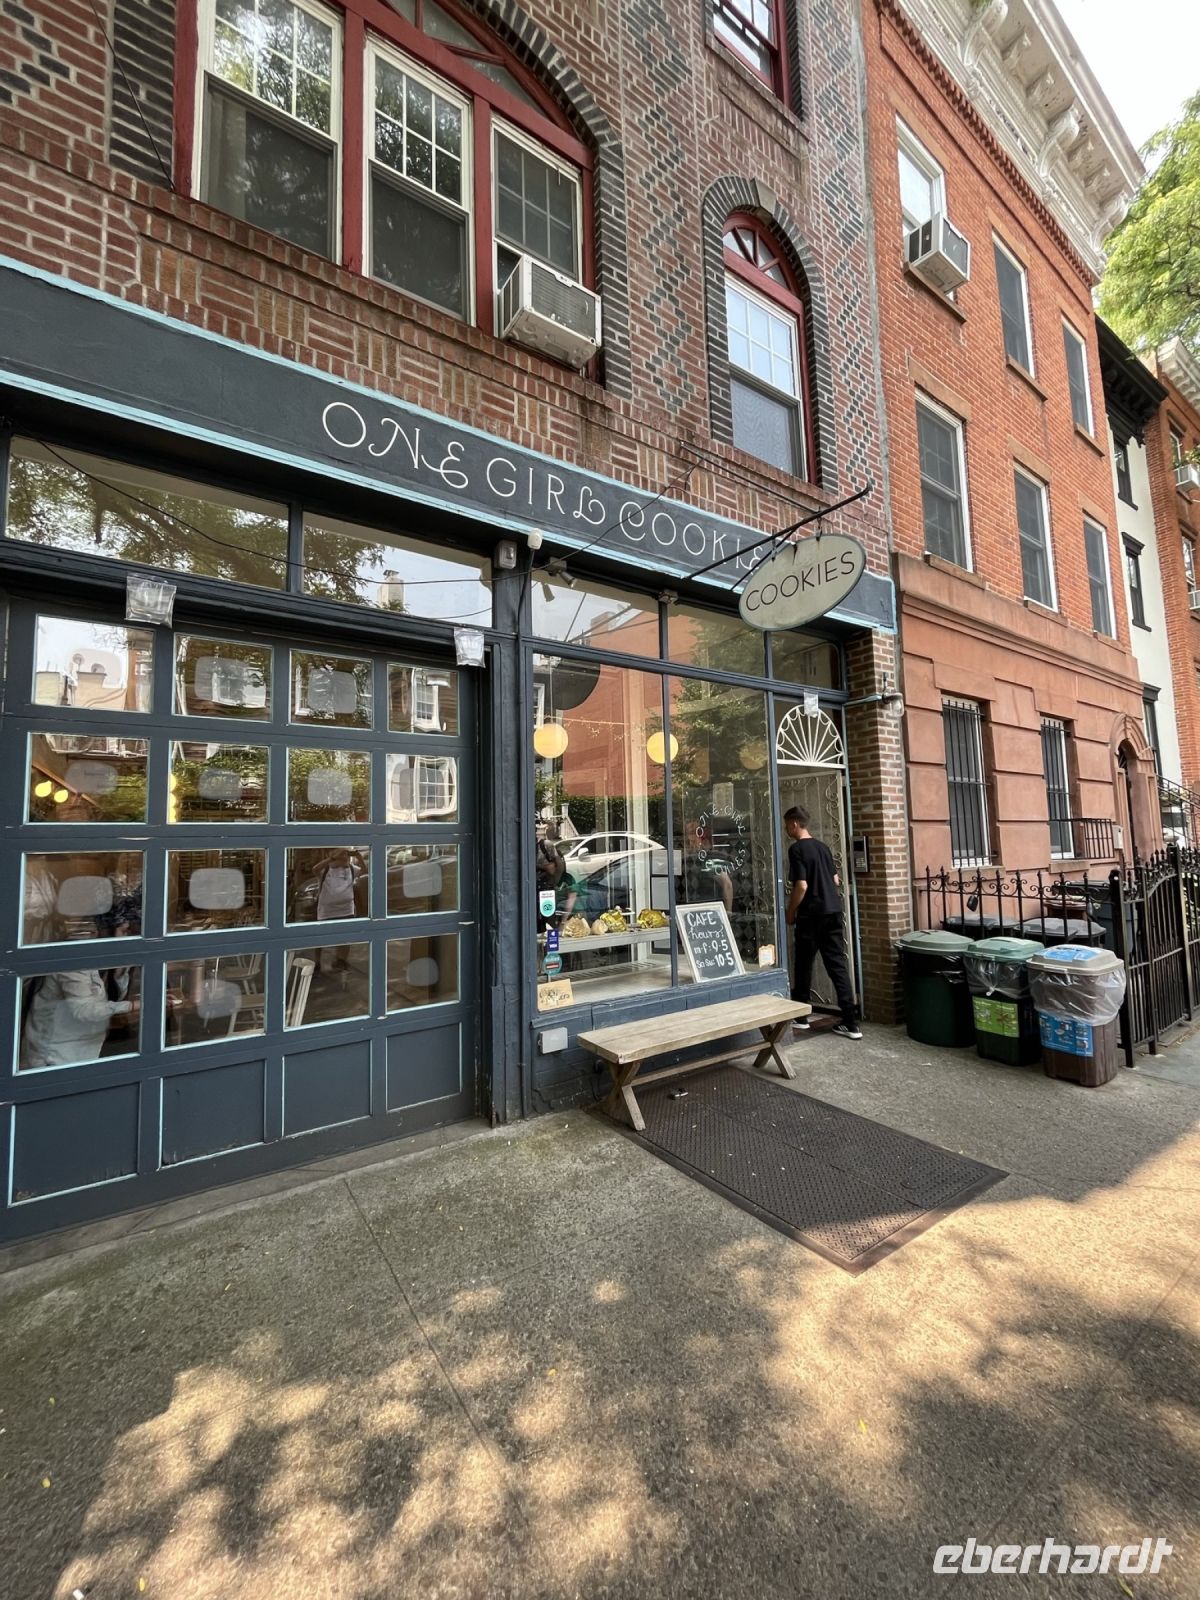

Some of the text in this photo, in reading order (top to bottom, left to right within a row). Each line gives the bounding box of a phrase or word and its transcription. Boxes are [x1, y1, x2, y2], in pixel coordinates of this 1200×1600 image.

[322, 401, 763, 576] ONE GIRL COOKIE
[745, 551, 855, 612] COOKIES
[686, 911, 717, 927] CAFE
